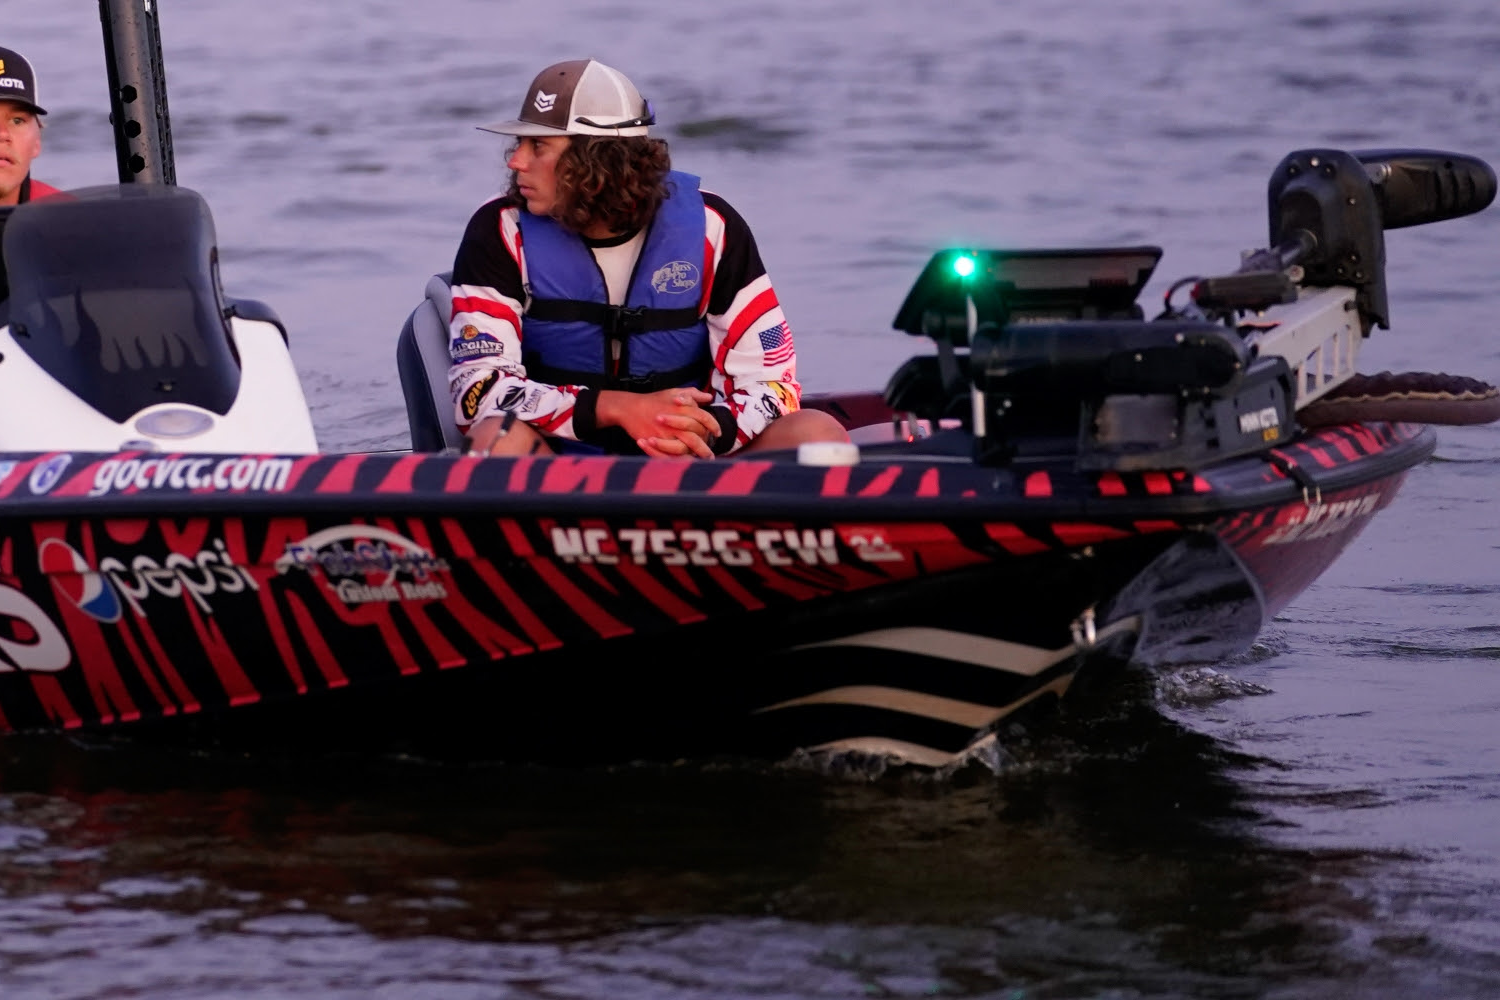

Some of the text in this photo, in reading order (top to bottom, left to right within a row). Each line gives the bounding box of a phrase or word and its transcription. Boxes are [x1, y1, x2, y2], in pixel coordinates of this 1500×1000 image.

[88, 457, 294, 497] gocvcc.com
[551, 527, 619, 565] NC
[99, 537, 260, 618] pepsi
